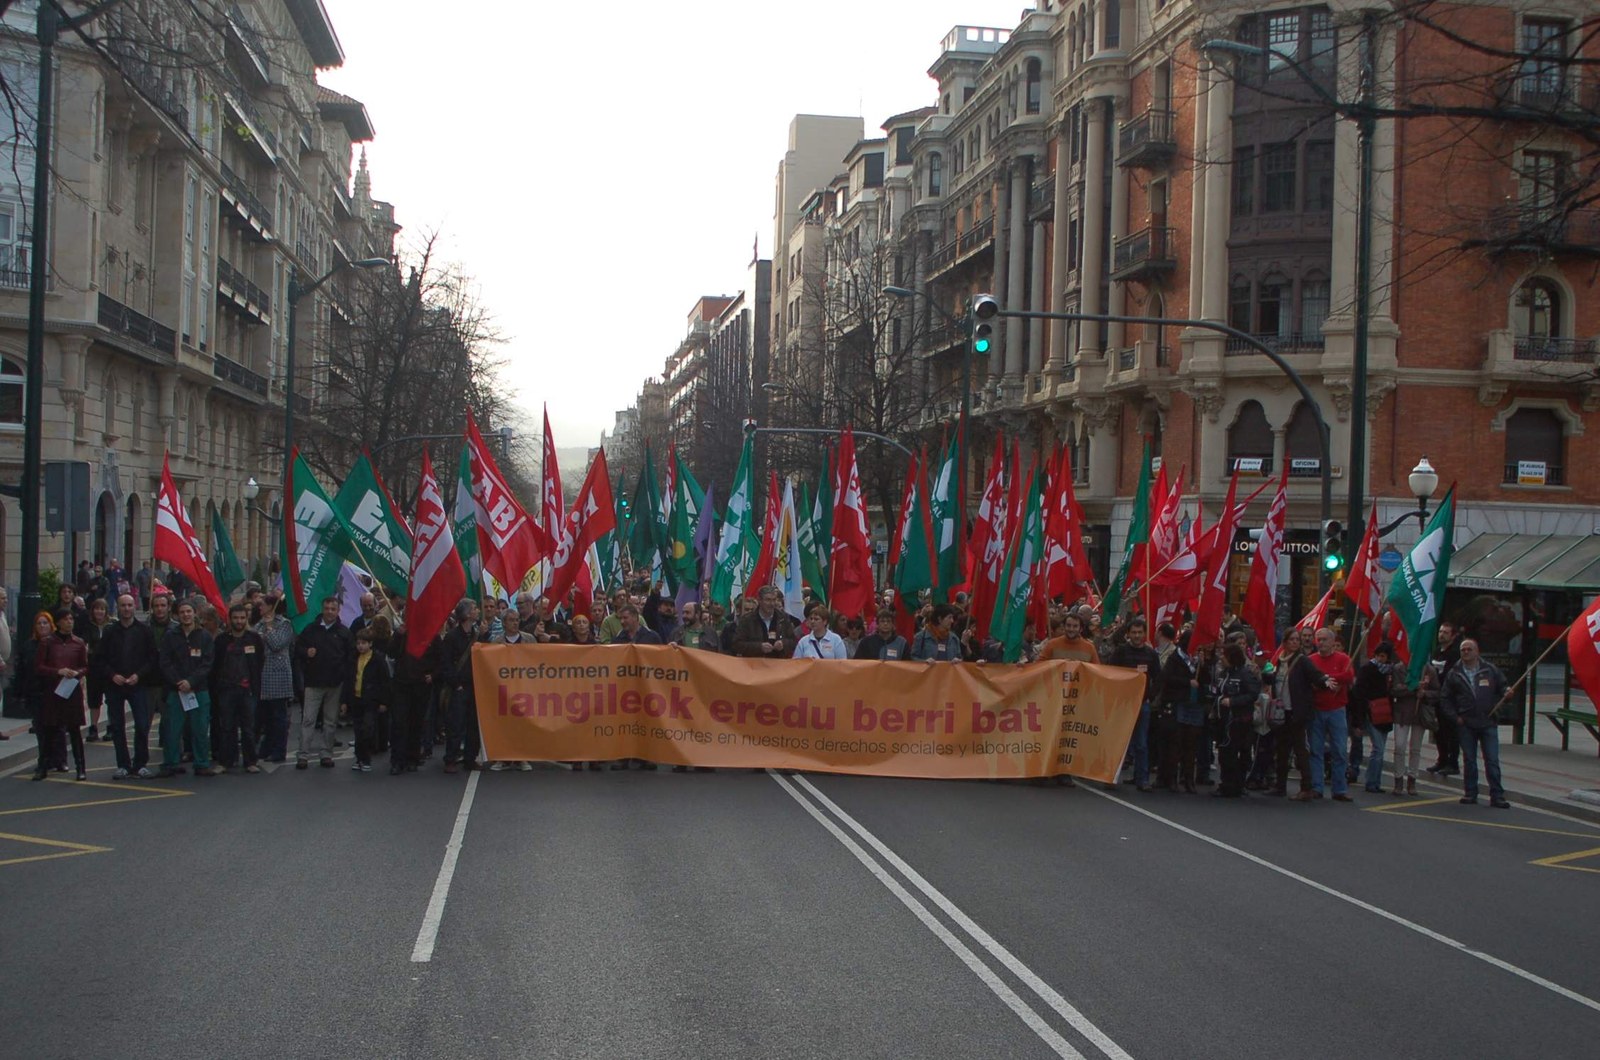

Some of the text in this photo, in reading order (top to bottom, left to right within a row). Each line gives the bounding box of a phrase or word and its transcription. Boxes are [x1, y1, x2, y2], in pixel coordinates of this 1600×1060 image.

[498, 663, 689, 682] erreformen aurrean
[498, 683, 1042, 734] langileok eredu berri bat
[594, 720, 1042, 758] no más recortes en nuestros derechos sociales y laborales
